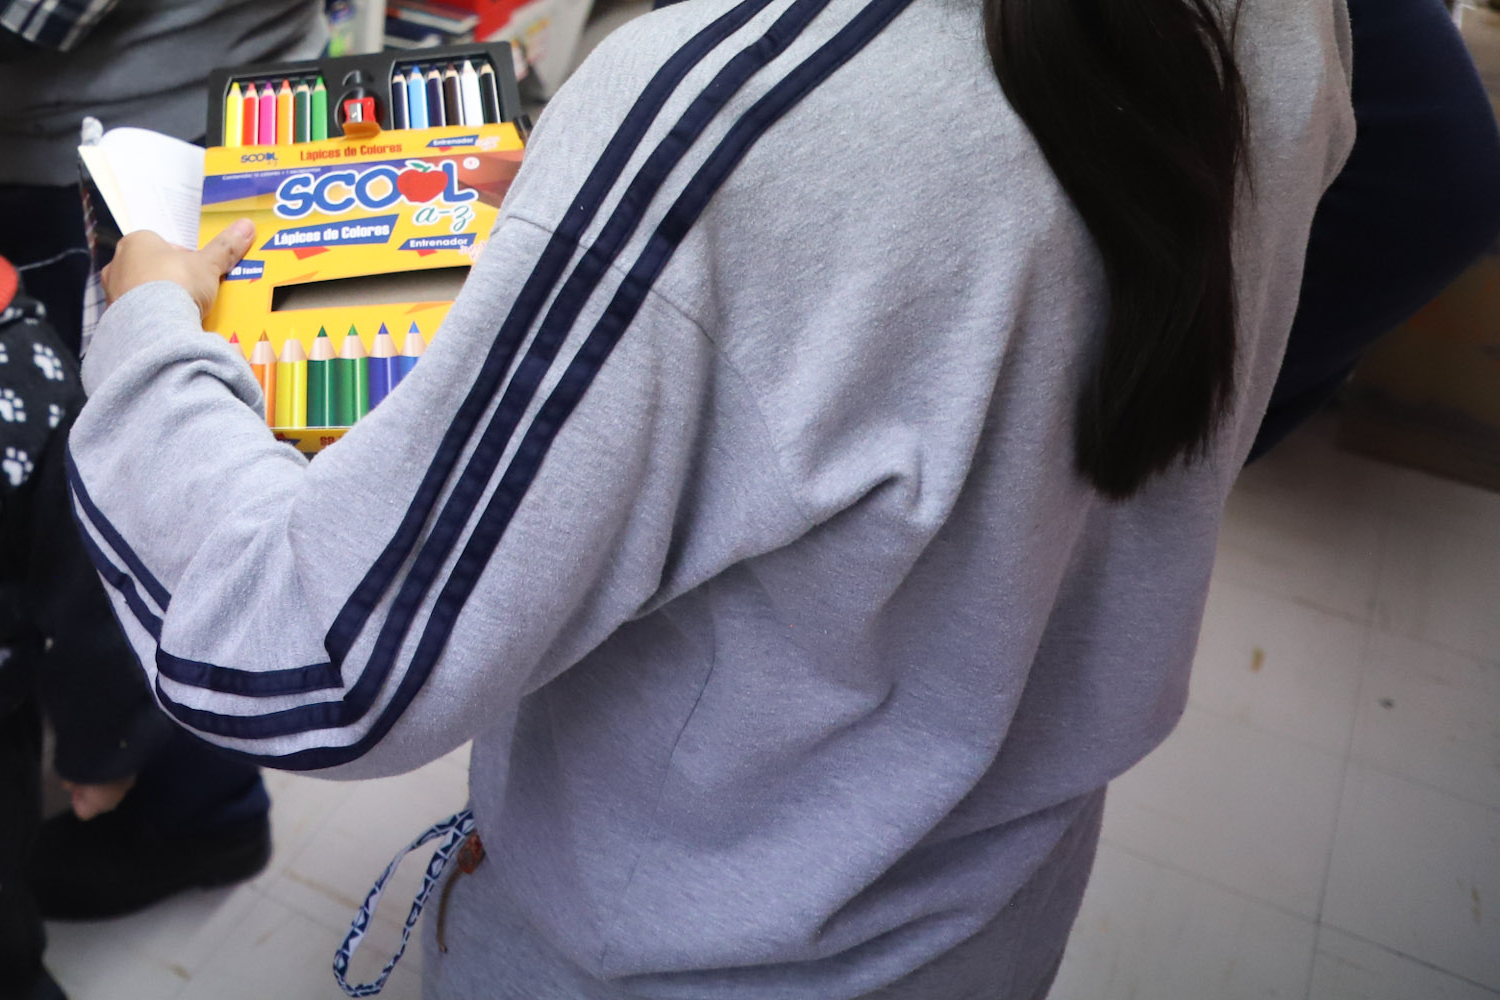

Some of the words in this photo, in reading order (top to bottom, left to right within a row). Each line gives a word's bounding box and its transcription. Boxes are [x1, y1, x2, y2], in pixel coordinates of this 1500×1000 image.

[344, 146, 357, 157] de
[360, 143, 402, 156] Colores
[274, 230, 321, 247] Lápices
[323, 228, 339, 241] de
[341, 224, 390, 239] Colores
[409, 238, 469, 248] Entrenador
